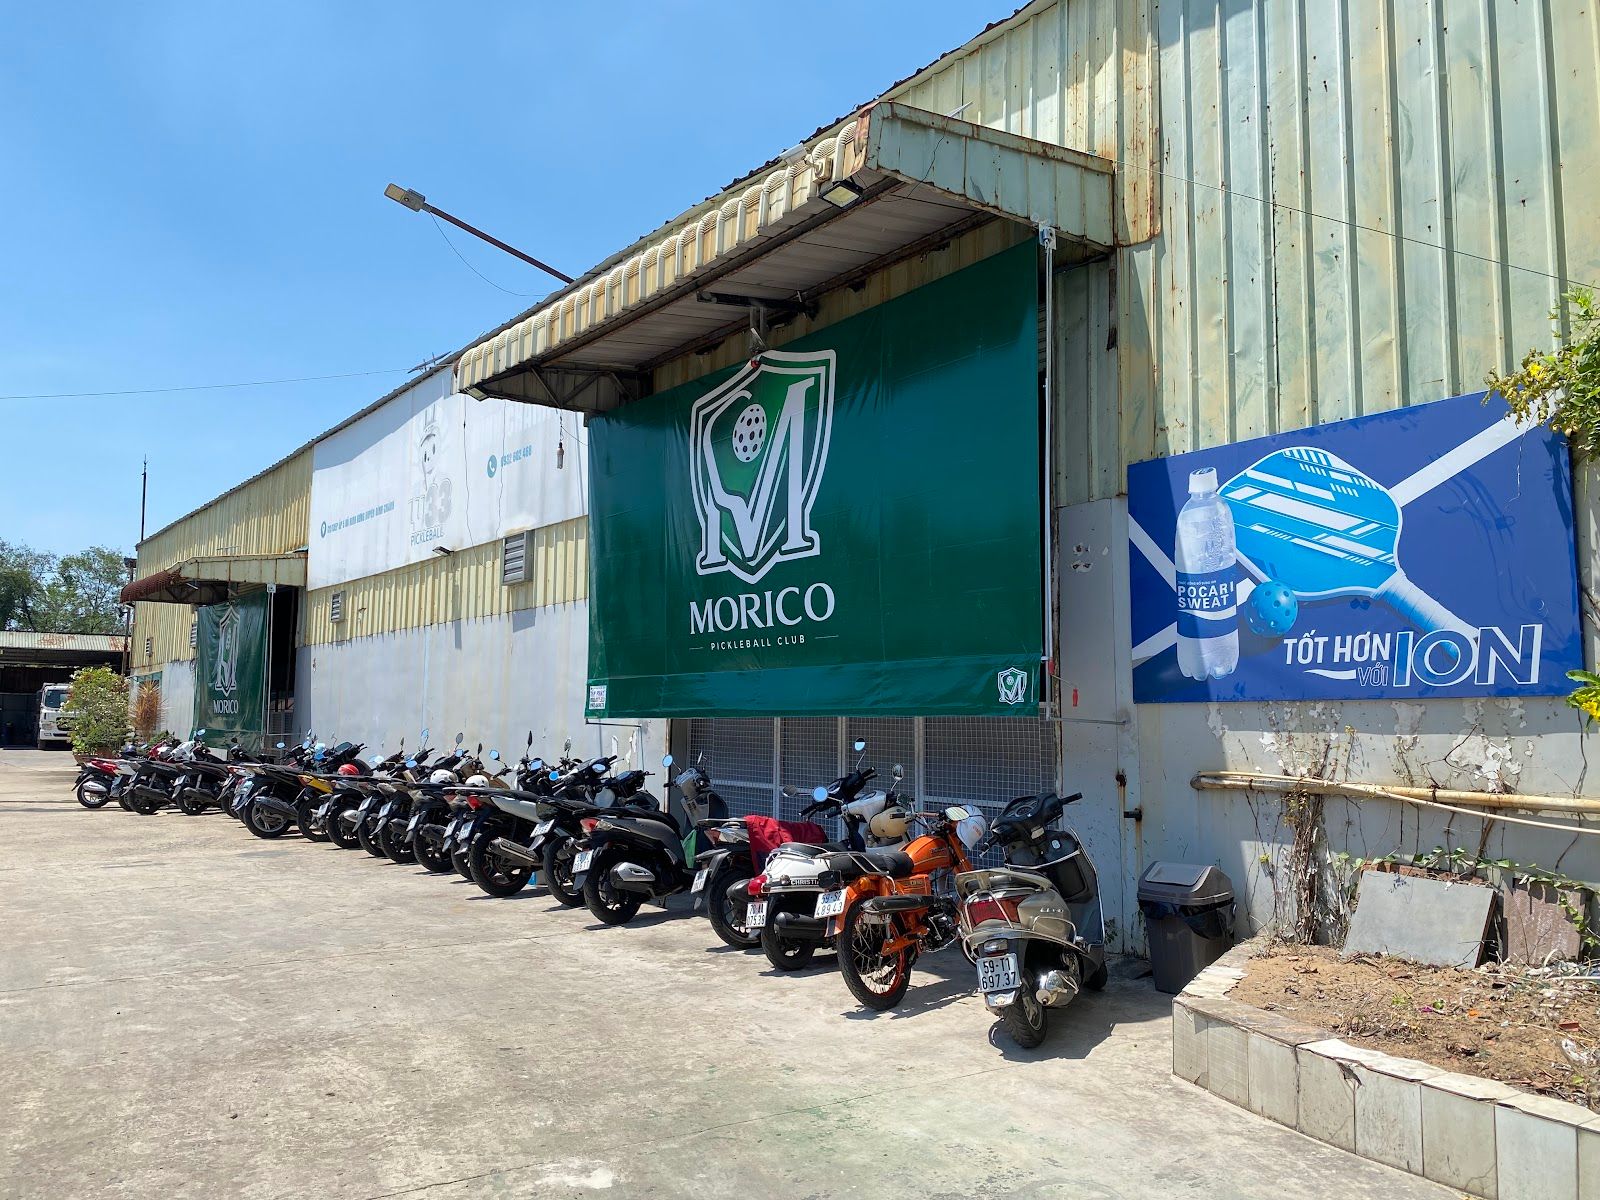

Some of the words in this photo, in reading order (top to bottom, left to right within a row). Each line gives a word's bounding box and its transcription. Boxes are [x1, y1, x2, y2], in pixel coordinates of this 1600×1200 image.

[411, 526, 444, 547] PICKLEBALL
[1177, 581, 1234, 598] POCARI
[689, 582, 835, 635] MORICO
[1177, 594, 1230, 609] SWEAT
[710, 639, 772, 651] PICKLEBALL
[777, 634, 805, 646] CLUB
[1283, 630, 1329, 665] TỐT
[1333, 631, 1391, 663] HƠN
[1392, 623, 1543, 687] ION
[1357, 662, 1389, 687] VỚI
[213, 700, 239, 714] MORICO
[983, 957, 1011, 974] 59-T1
[981, 971, 1016, 990] 697.37
